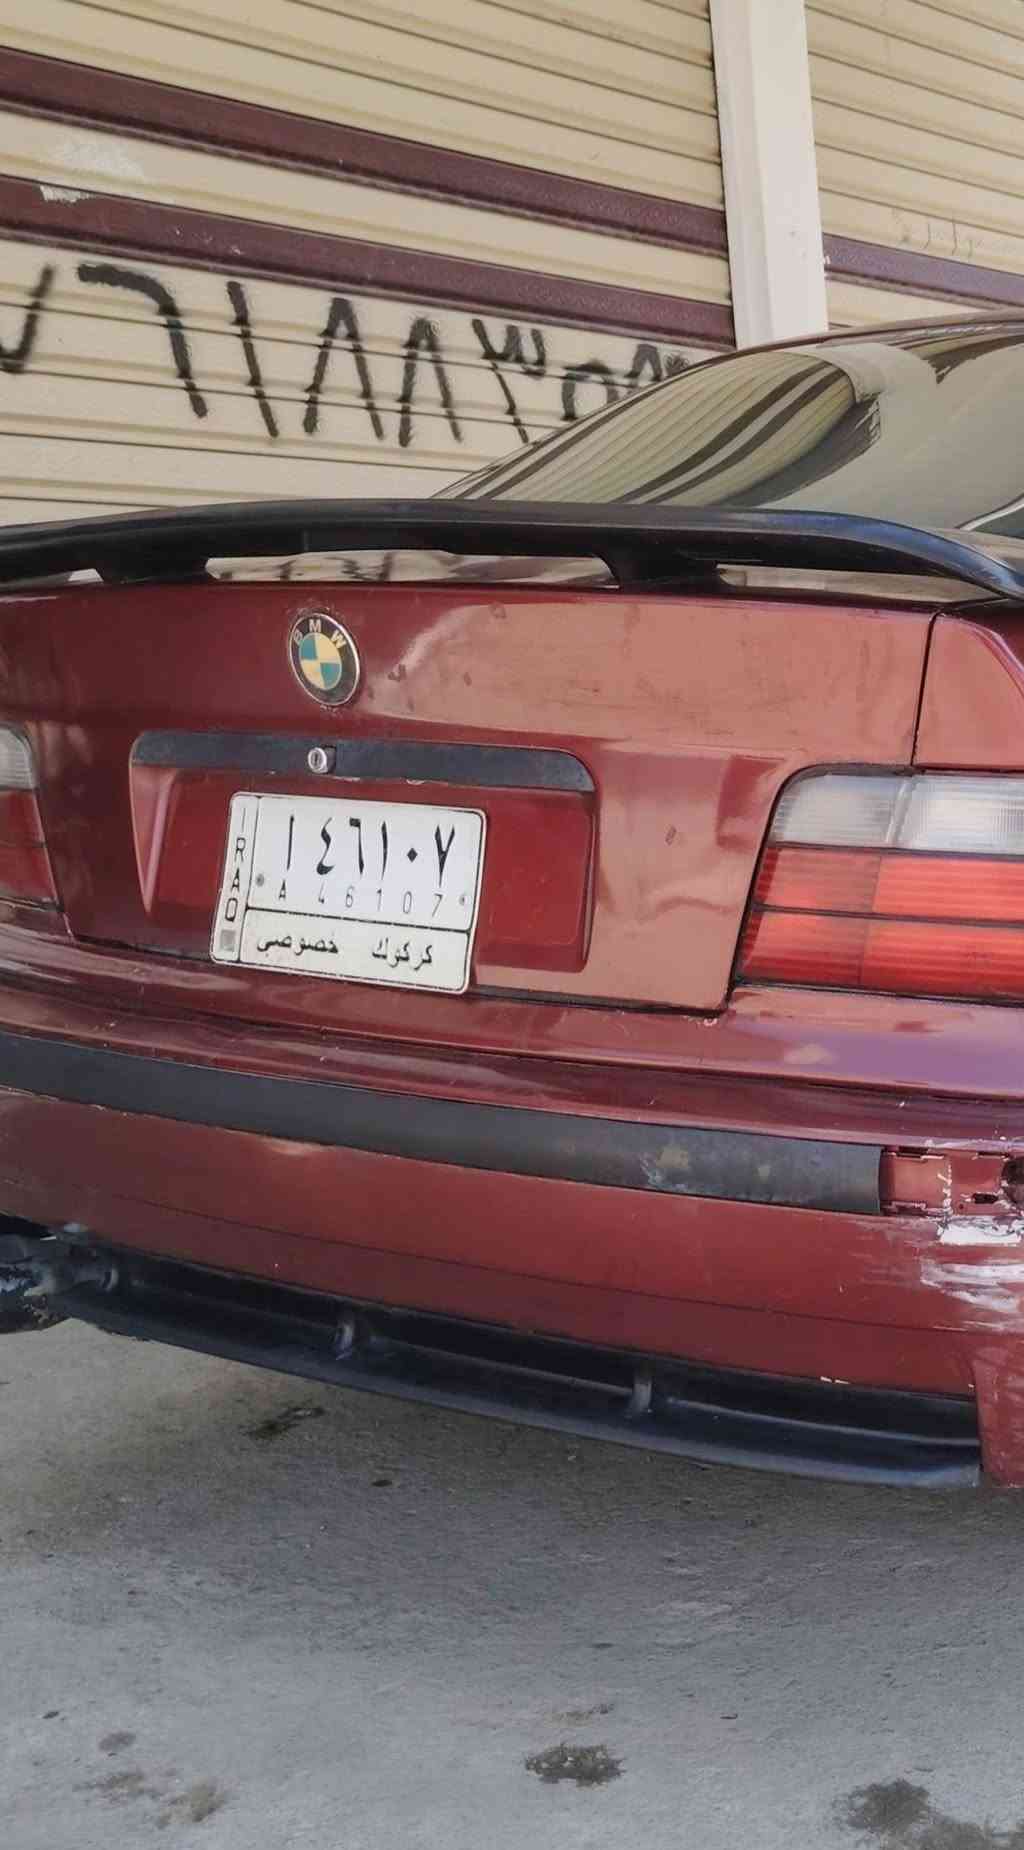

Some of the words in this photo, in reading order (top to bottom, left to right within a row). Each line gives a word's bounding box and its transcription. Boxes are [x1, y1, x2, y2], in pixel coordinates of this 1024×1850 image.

[293, 619, 347, 646] BMW
[225, 807, 247, 921] IRAQ
[256, 936, 339, 957] خصوصي
[371, 937, 433, 971] كركوك
